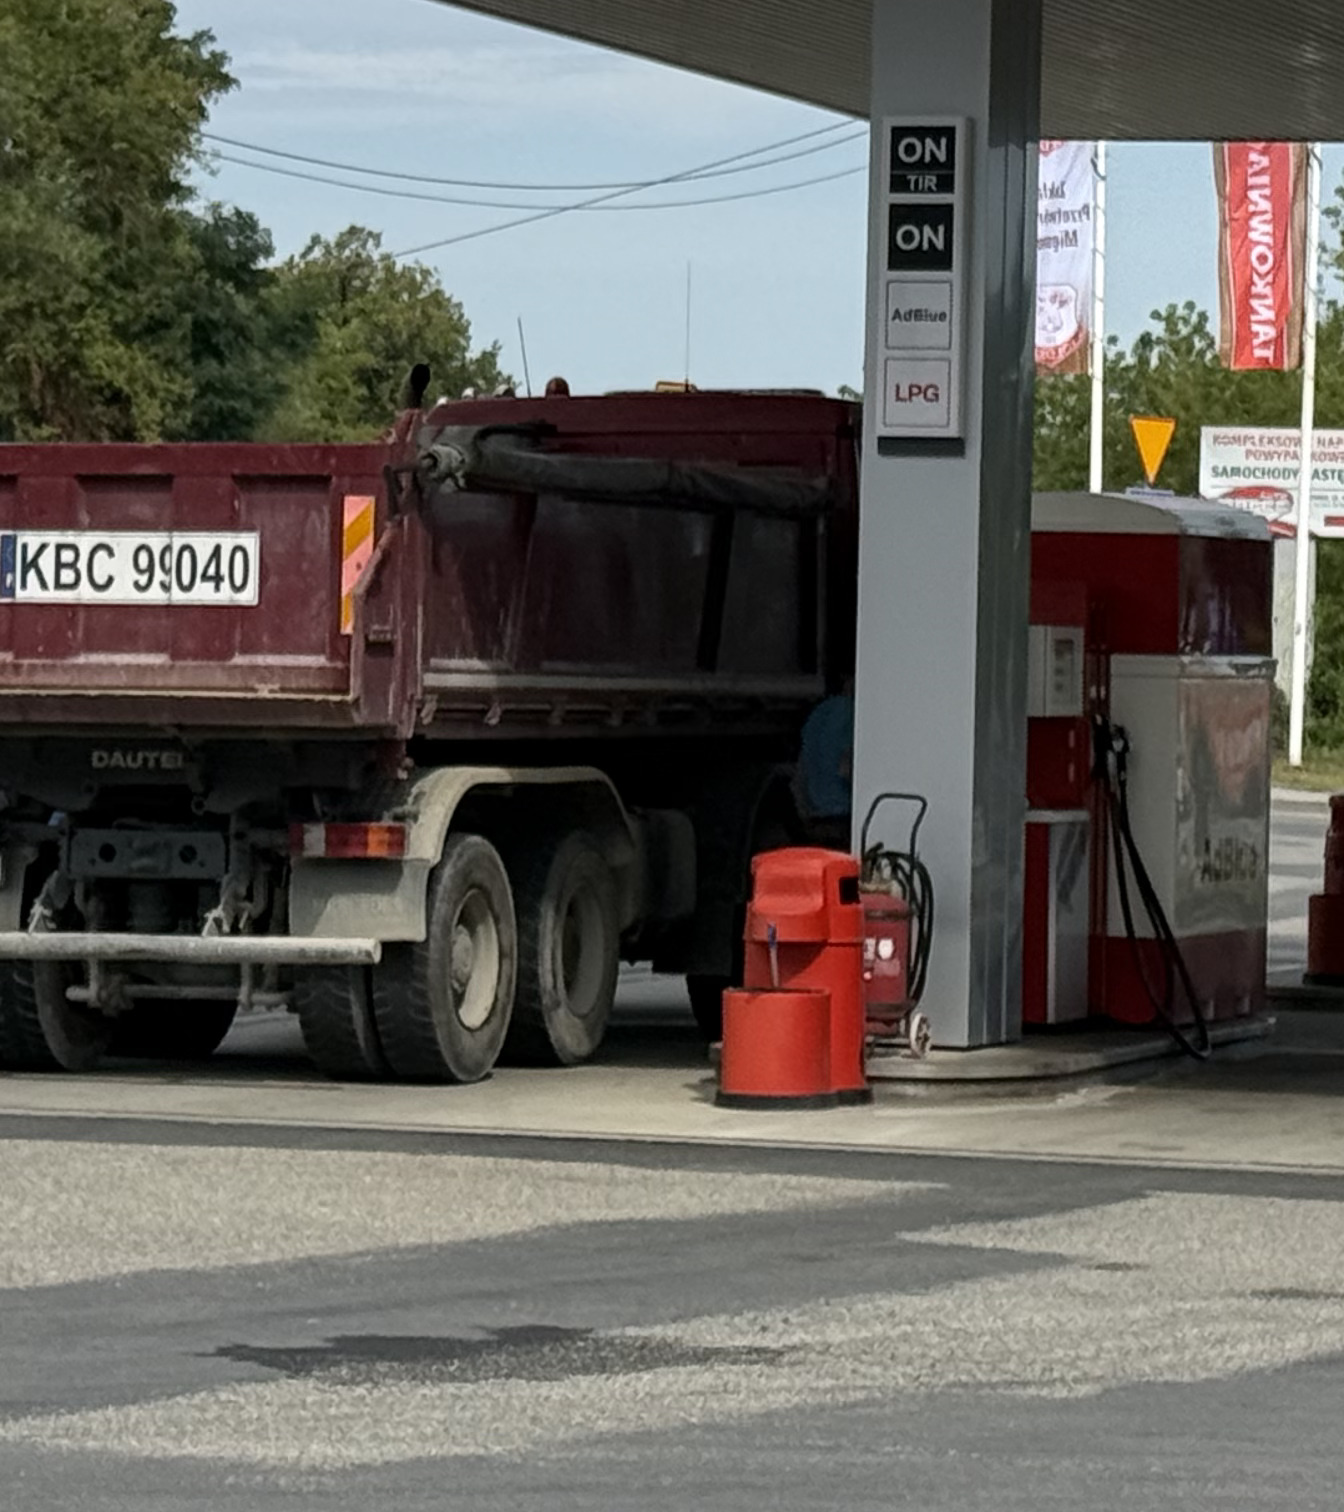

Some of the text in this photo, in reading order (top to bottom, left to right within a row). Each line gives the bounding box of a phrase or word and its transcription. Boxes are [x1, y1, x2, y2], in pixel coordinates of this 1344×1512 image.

[897, 137, 947, 164] ON
[907, 175, 938, 192] TIR
[895, 224, 946, 252] ON
[892, 308, 947, 322] AdBlue
[894, 383, 940, 404] LPG
[1213, 434, 1303, 450] KOMPLEKSOW
[1211, 465, 1300, 479] SAMOCHODY
[19, 542, 250, 593] KBC 99040
